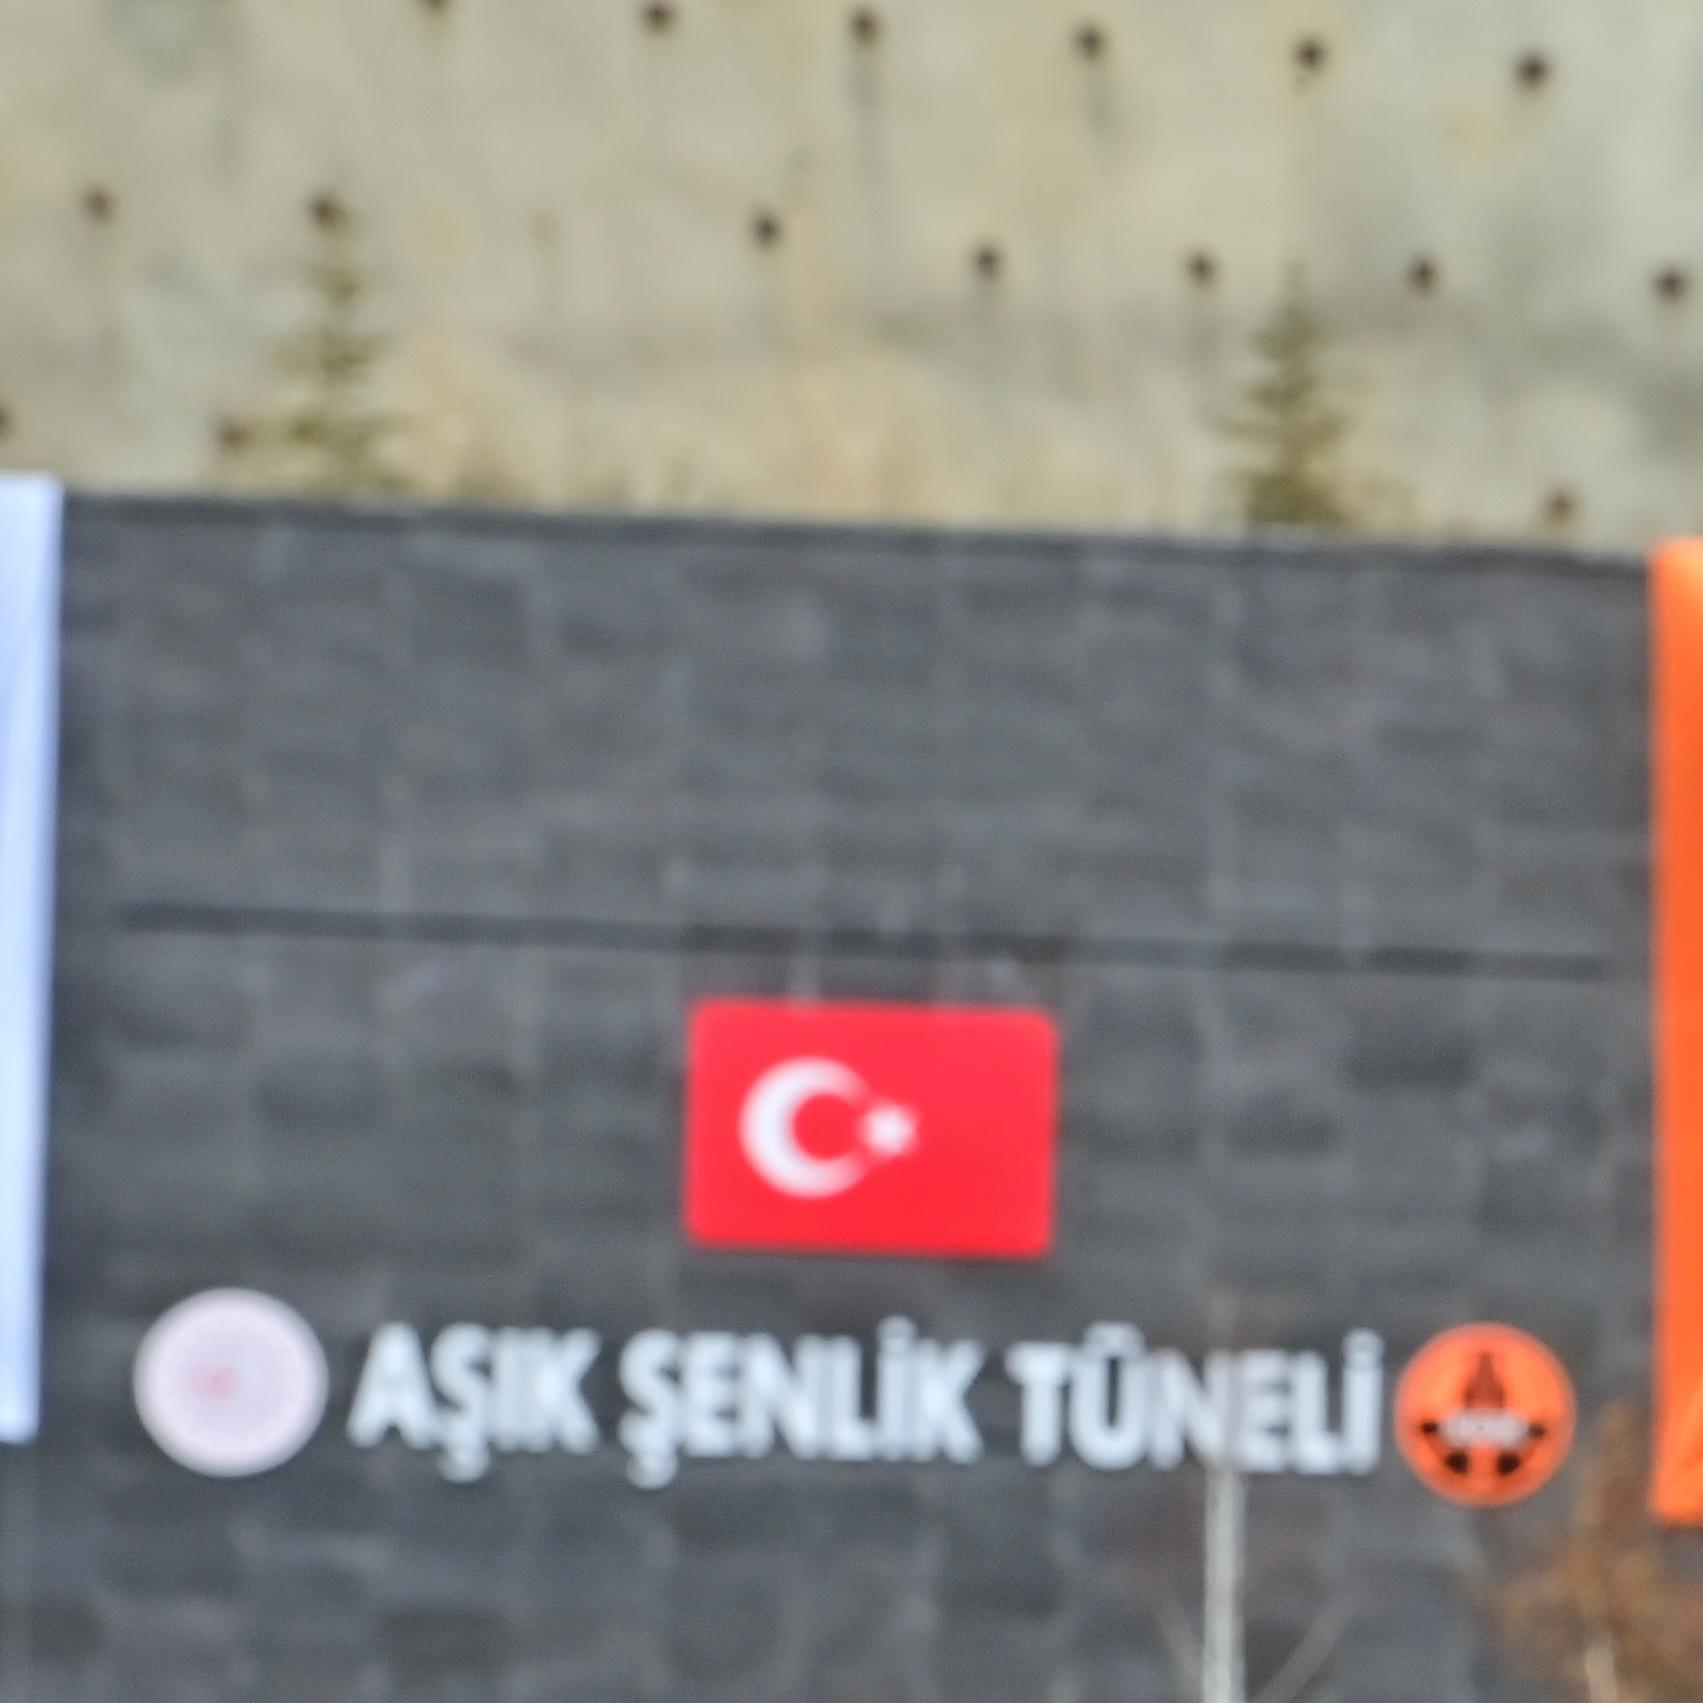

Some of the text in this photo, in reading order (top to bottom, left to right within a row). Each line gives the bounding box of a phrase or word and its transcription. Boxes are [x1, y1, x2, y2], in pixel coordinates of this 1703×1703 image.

[349, 1316, 1384, 1488] AŞIK ŞENLİK TÜNELİ
